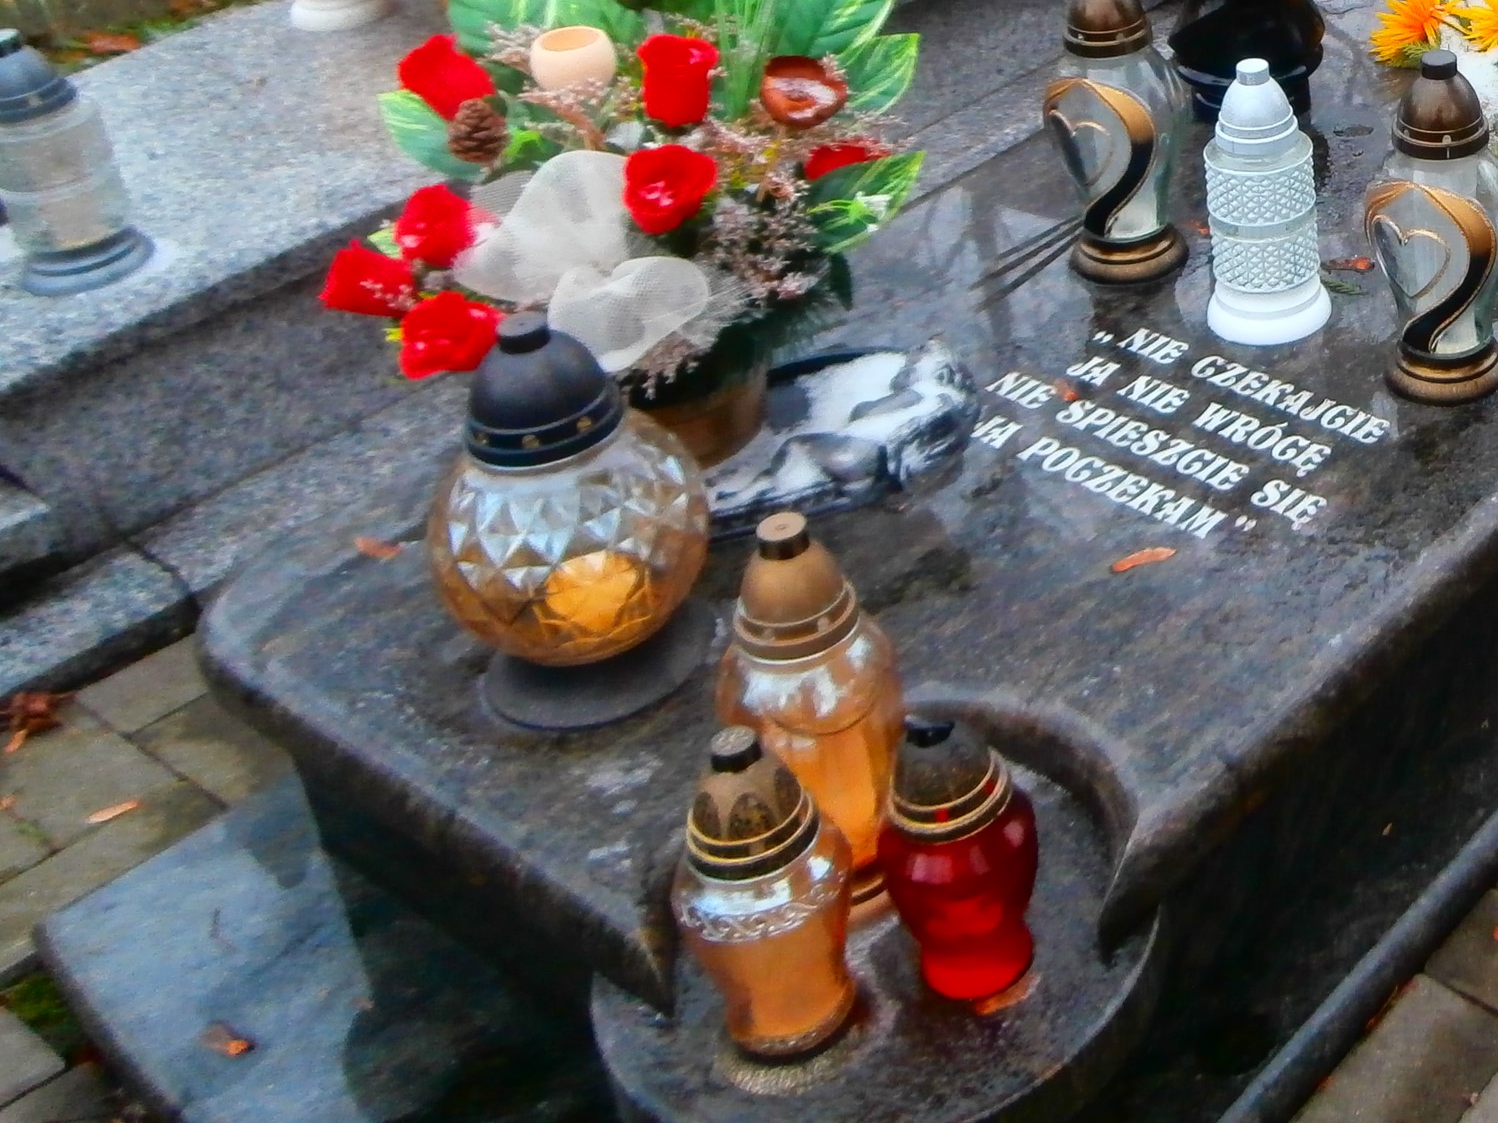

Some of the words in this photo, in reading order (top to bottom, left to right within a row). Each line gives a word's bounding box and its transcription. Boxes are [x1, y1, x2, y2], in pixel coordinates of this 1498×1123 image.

[972, 415, 1023, 449] JA
[985, 371, 1057, 410] NIE
[1251, 477, 1327, 531] SIĘ
[1065, 355, 1121, 387] JA
[1116, 375, 1190, 415] NIE
[1192, 401, 1332, 477] WRÓCĘ
[1191, 355, 1390, 445] CZEKAJCIE
